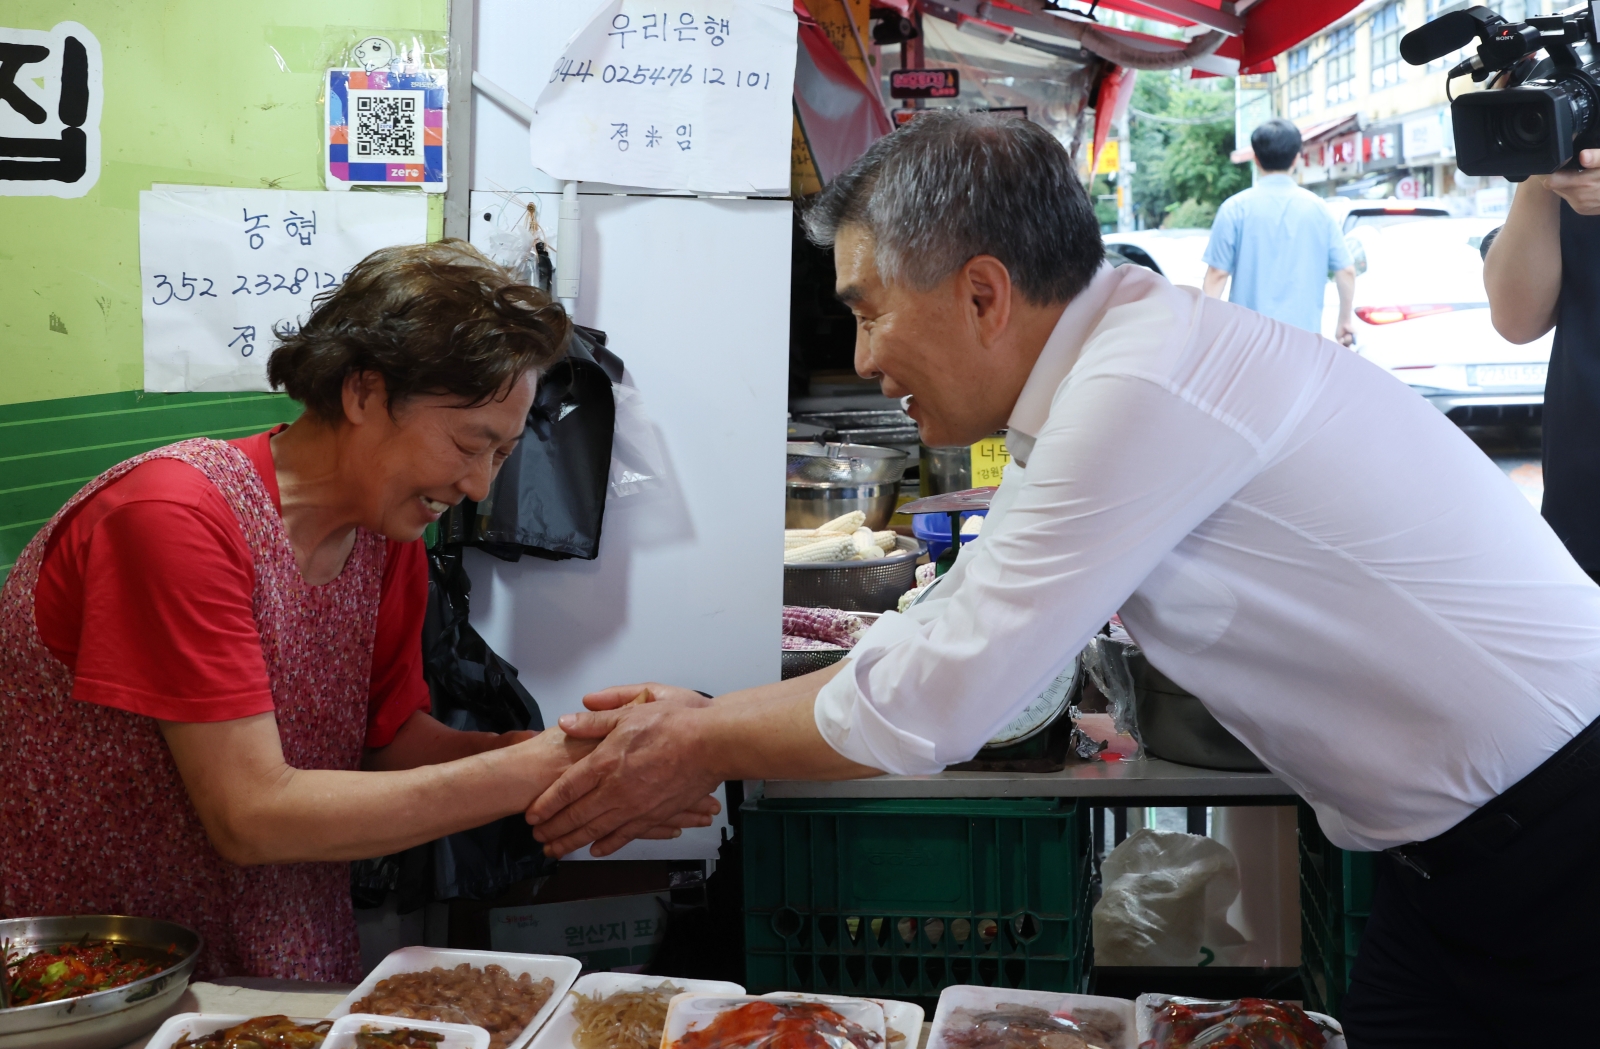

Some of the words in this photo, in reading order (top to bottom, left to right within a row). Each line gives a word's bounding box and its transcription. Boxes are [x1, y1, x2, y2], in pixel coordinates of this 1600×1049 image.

[607, 12, 730, 49] 우리은행
[602, 64, 693, 87] 025476
[391, 168, 420, 178] zero
[152, 271, 217, 305] 352
[227, 325, 256, 357] 정
[564, 921, 627, 947] 원산지
